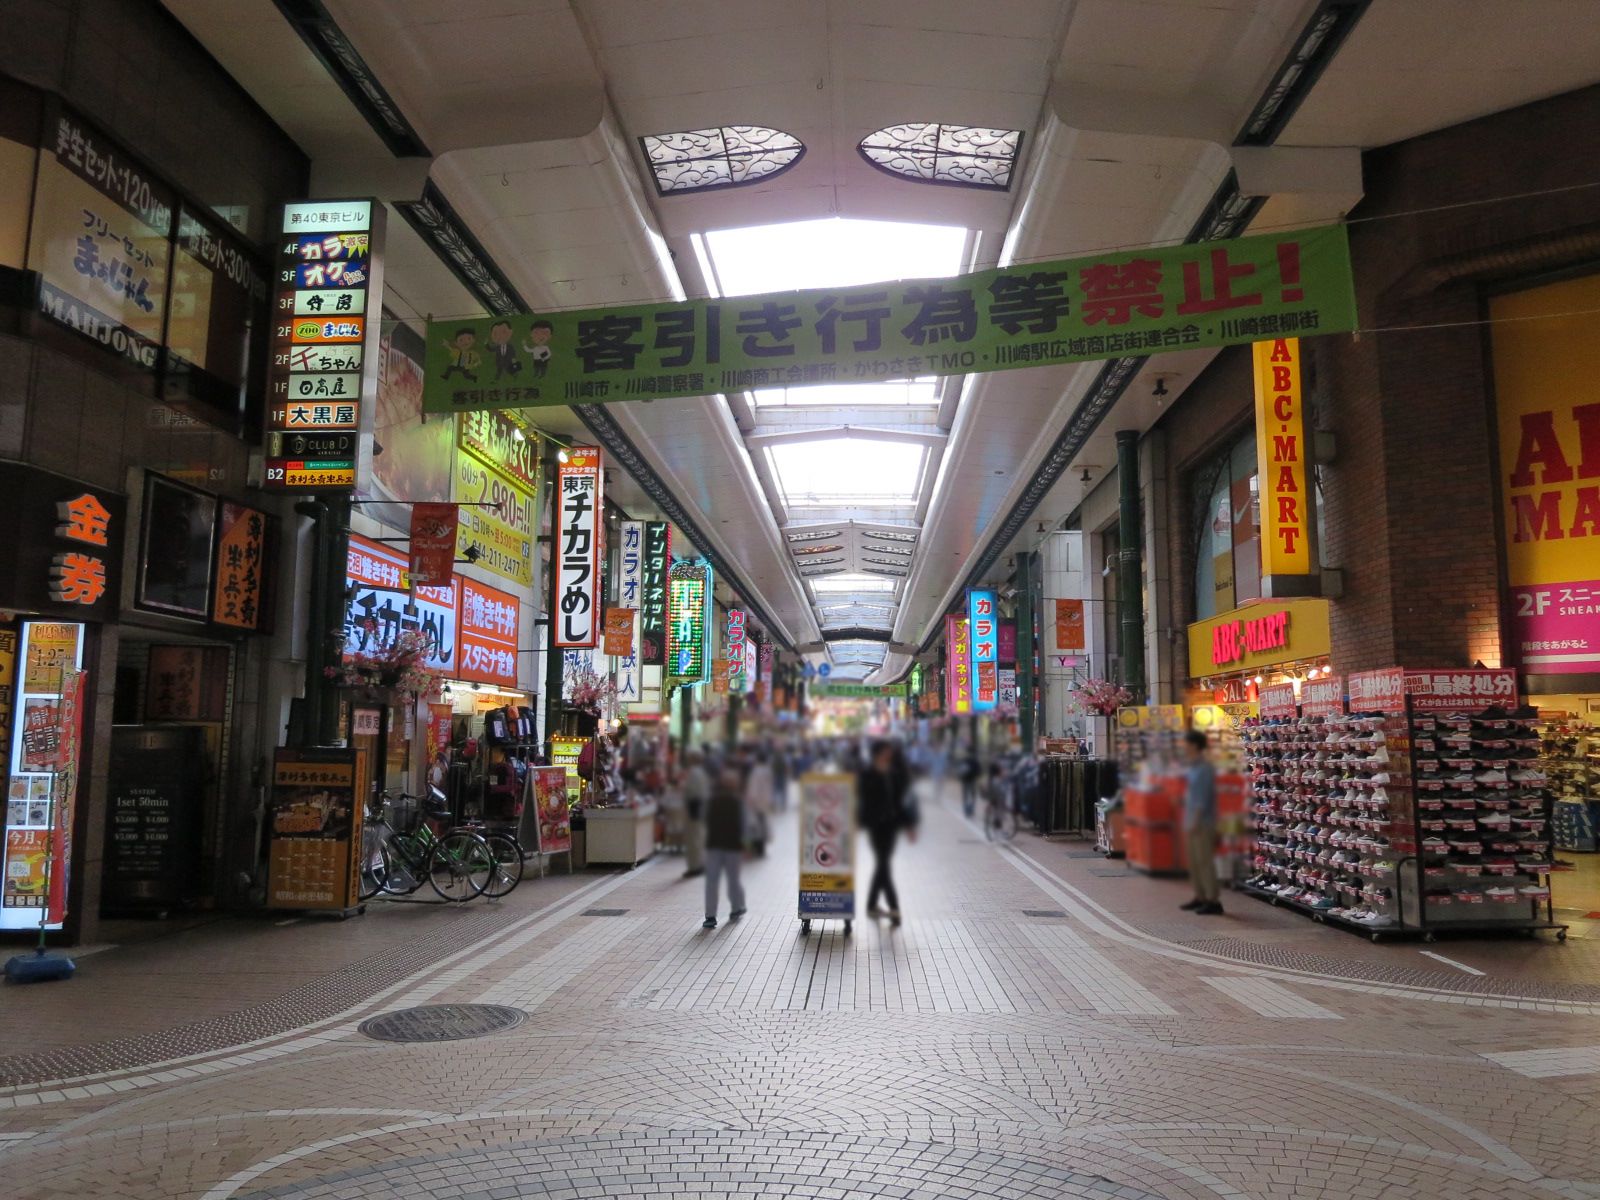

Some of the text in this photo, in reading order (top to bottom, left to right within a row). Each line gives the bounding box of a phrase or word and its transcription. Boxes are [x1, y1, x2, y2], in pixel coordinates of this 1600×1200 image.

[291, 212, 365, 225] 第40東京ビル
[83, 208, 154, 268] フリーセット
[284, 243, 299, 255] 4F
[302, 236, 342, 260] カラ
[281, 270, 297, 282] 3F
[304, 262, 347, 286] オケ
[279, 298, 294, 309] 3F
[575, 241, 1306, 374] 客引き行為等禁止!
[40, 289, 158, 368] MAHJONG
[277, 326, 292, 337] 2F
[275, 354, 289, 365] 2F
[274, 382, 288, 393] 1F
[299, 377, 347, 396] 日高屋
[272, 410, 285, 422] 1F
[290, 406, 354, 424] 大黒屋
[268, 468, 284, 480] B2
[563, 476, 595, 493] 東京
[56, 492, 113, 606] 金券
[361, 556, 400, 588] 焼き牛丼
[561, 492, 593, 642] チカラめし
[650, 522, 667, 631] インターネット
[1517, 591, 1552, 616] 2F
[472, 593, 516, 638] 焼き牛丼
[727, 608, 745, 677] カラオケ
[1211, 610, 1288, 665] ABC-MART
[462, 643, 515, 678] スタミナ定食
[1222, 681, 1248, 702] SALE
[1431, 674, 1514, 696] 最終処分
[138, 797, 169, 807] 50min
